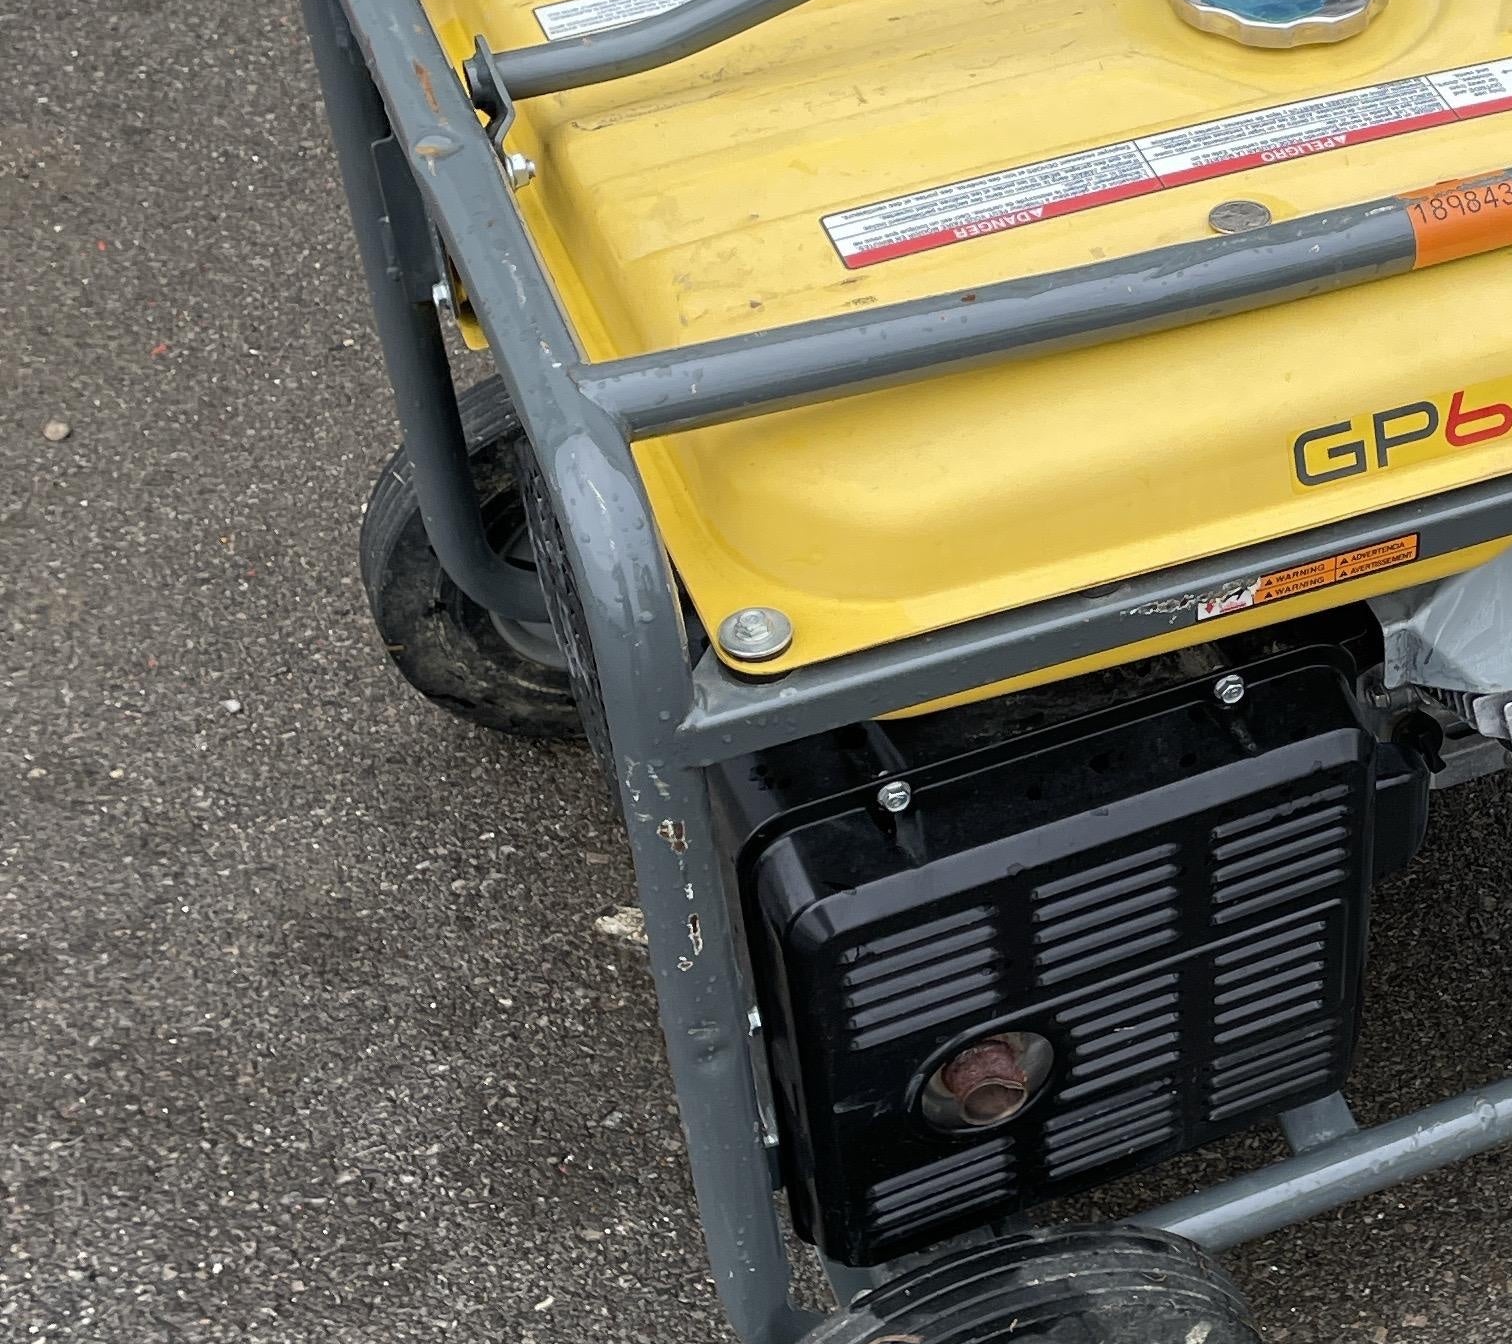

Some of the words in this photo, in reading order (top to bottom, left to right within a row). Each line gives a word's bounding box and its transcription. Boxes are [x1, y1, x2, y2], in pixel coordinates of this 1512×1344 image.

[1257, 136, 1336, 163] PELIGRO
[951, 210, 1032, 239] DANGER
[1351, 541, 1406, 562] ADVERTENCIA
[1275, 563, 1325, 583] WARNING
[1350, 551, 1413, 575] AVERTISSEMENT
[1274, 576, 1325, 596] WARNING
